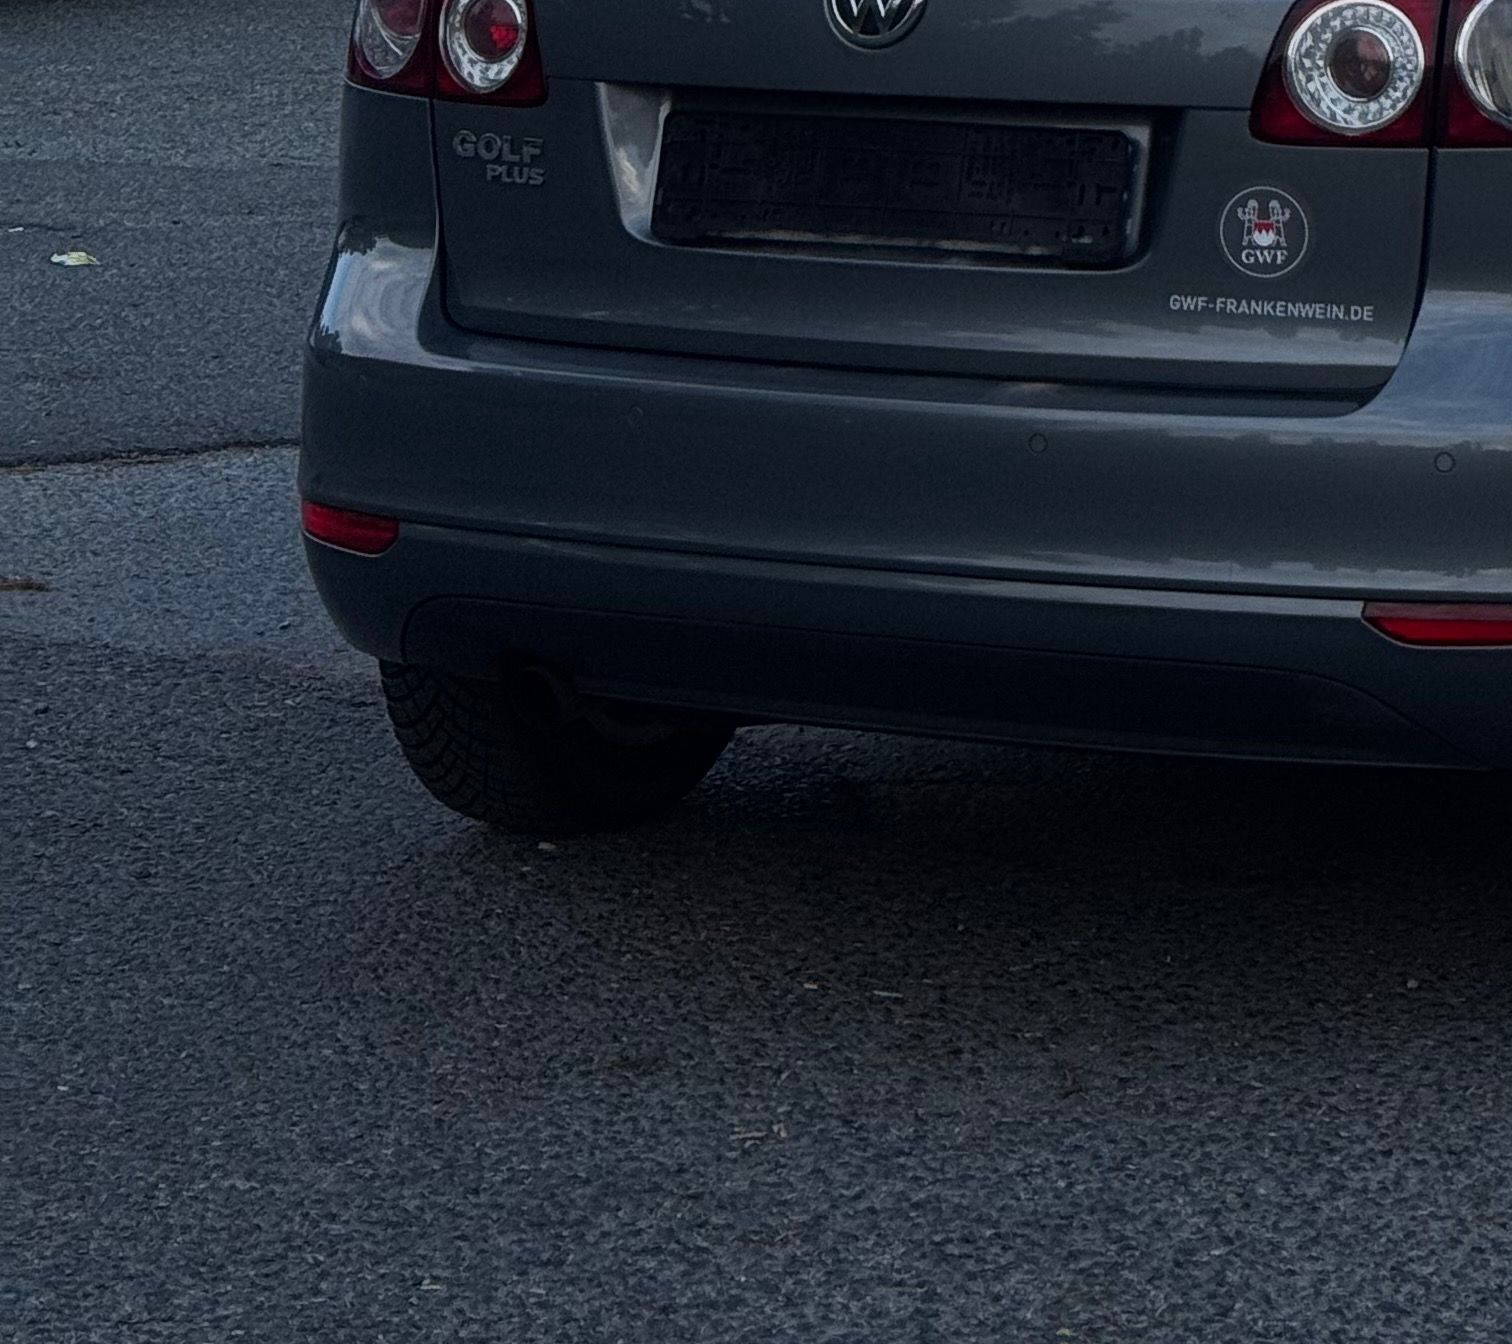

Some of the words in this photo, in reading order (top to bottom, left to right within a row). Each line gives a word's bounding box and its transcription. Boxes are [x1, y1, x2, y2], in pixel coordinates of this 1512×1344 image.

[452, 129, 544, 163] GOLF
[486, 163, 545, 185] PLUS
[1241, 248, 1289, 265] GWF
[1169, 294, 1375, 322] GWF-FRANKENWEIN.DE
